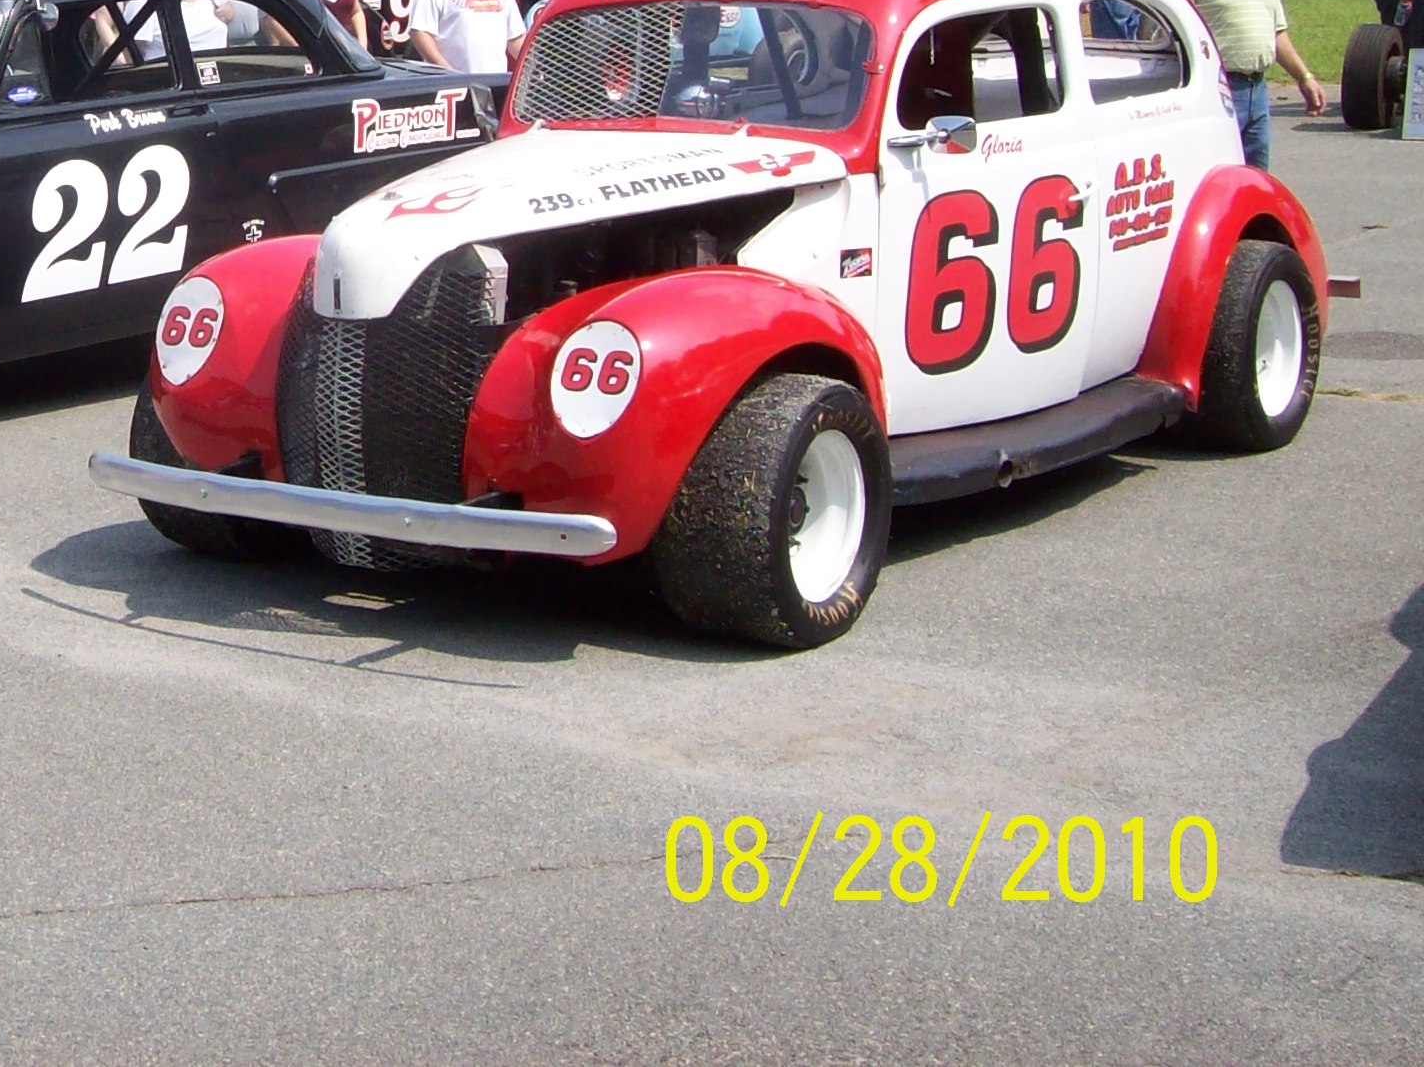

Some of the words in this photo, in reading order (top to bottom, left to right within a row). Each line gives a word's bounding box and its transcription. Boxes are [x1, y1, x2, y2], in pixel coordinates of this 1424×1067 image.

[353, 88, 468, 153] PIEDMONT
[981, 133, 1023, 164] Gloria
[528, 193, 575, 214] 239
[598, 167, 726, 201] FLATHEAD
[1105, 189, 1141, 218] AUTO
[21, 144, 191, 303] 22
[905, 174, 1085, 376] 66
[161, 304, 219, 349] 66
[560, 347, 634, 395] 66
